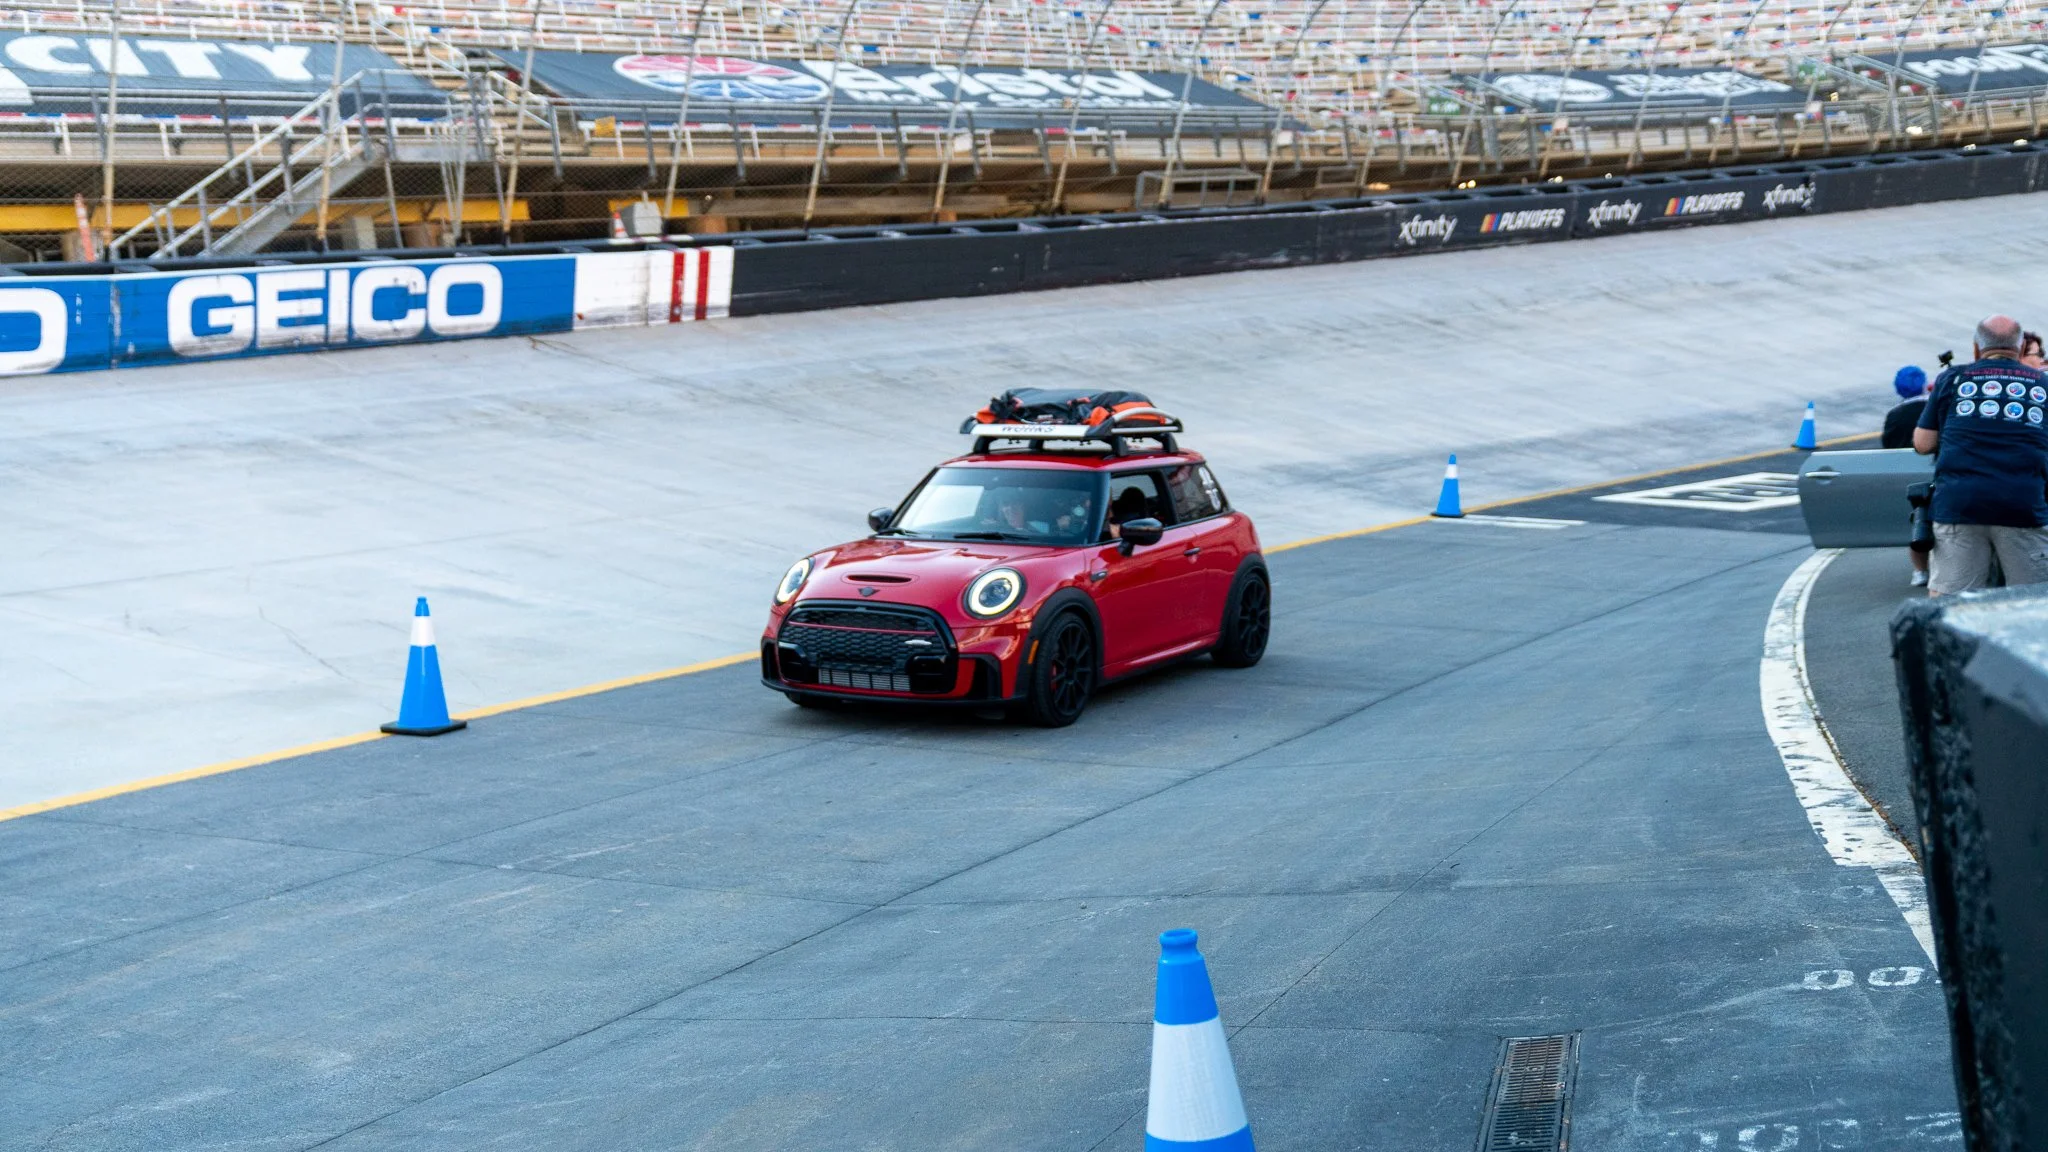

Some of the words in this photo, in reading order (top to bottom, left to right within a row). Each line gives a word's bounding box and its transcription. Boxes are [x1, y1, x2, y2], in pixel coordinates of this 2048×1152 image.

[5, 35, 314, 81] CITY
[801, 59, 1173, 99] Bristol
[1399, 213, 1459, 245] xfinity
[1498, 207, 1567, 232] PLAYOFFS
[1587, 199, 1643, 229] xfinity
[1681, 190, 1746, 215] PLAYOFFS
[167, 262, 503, 358] GEICO
